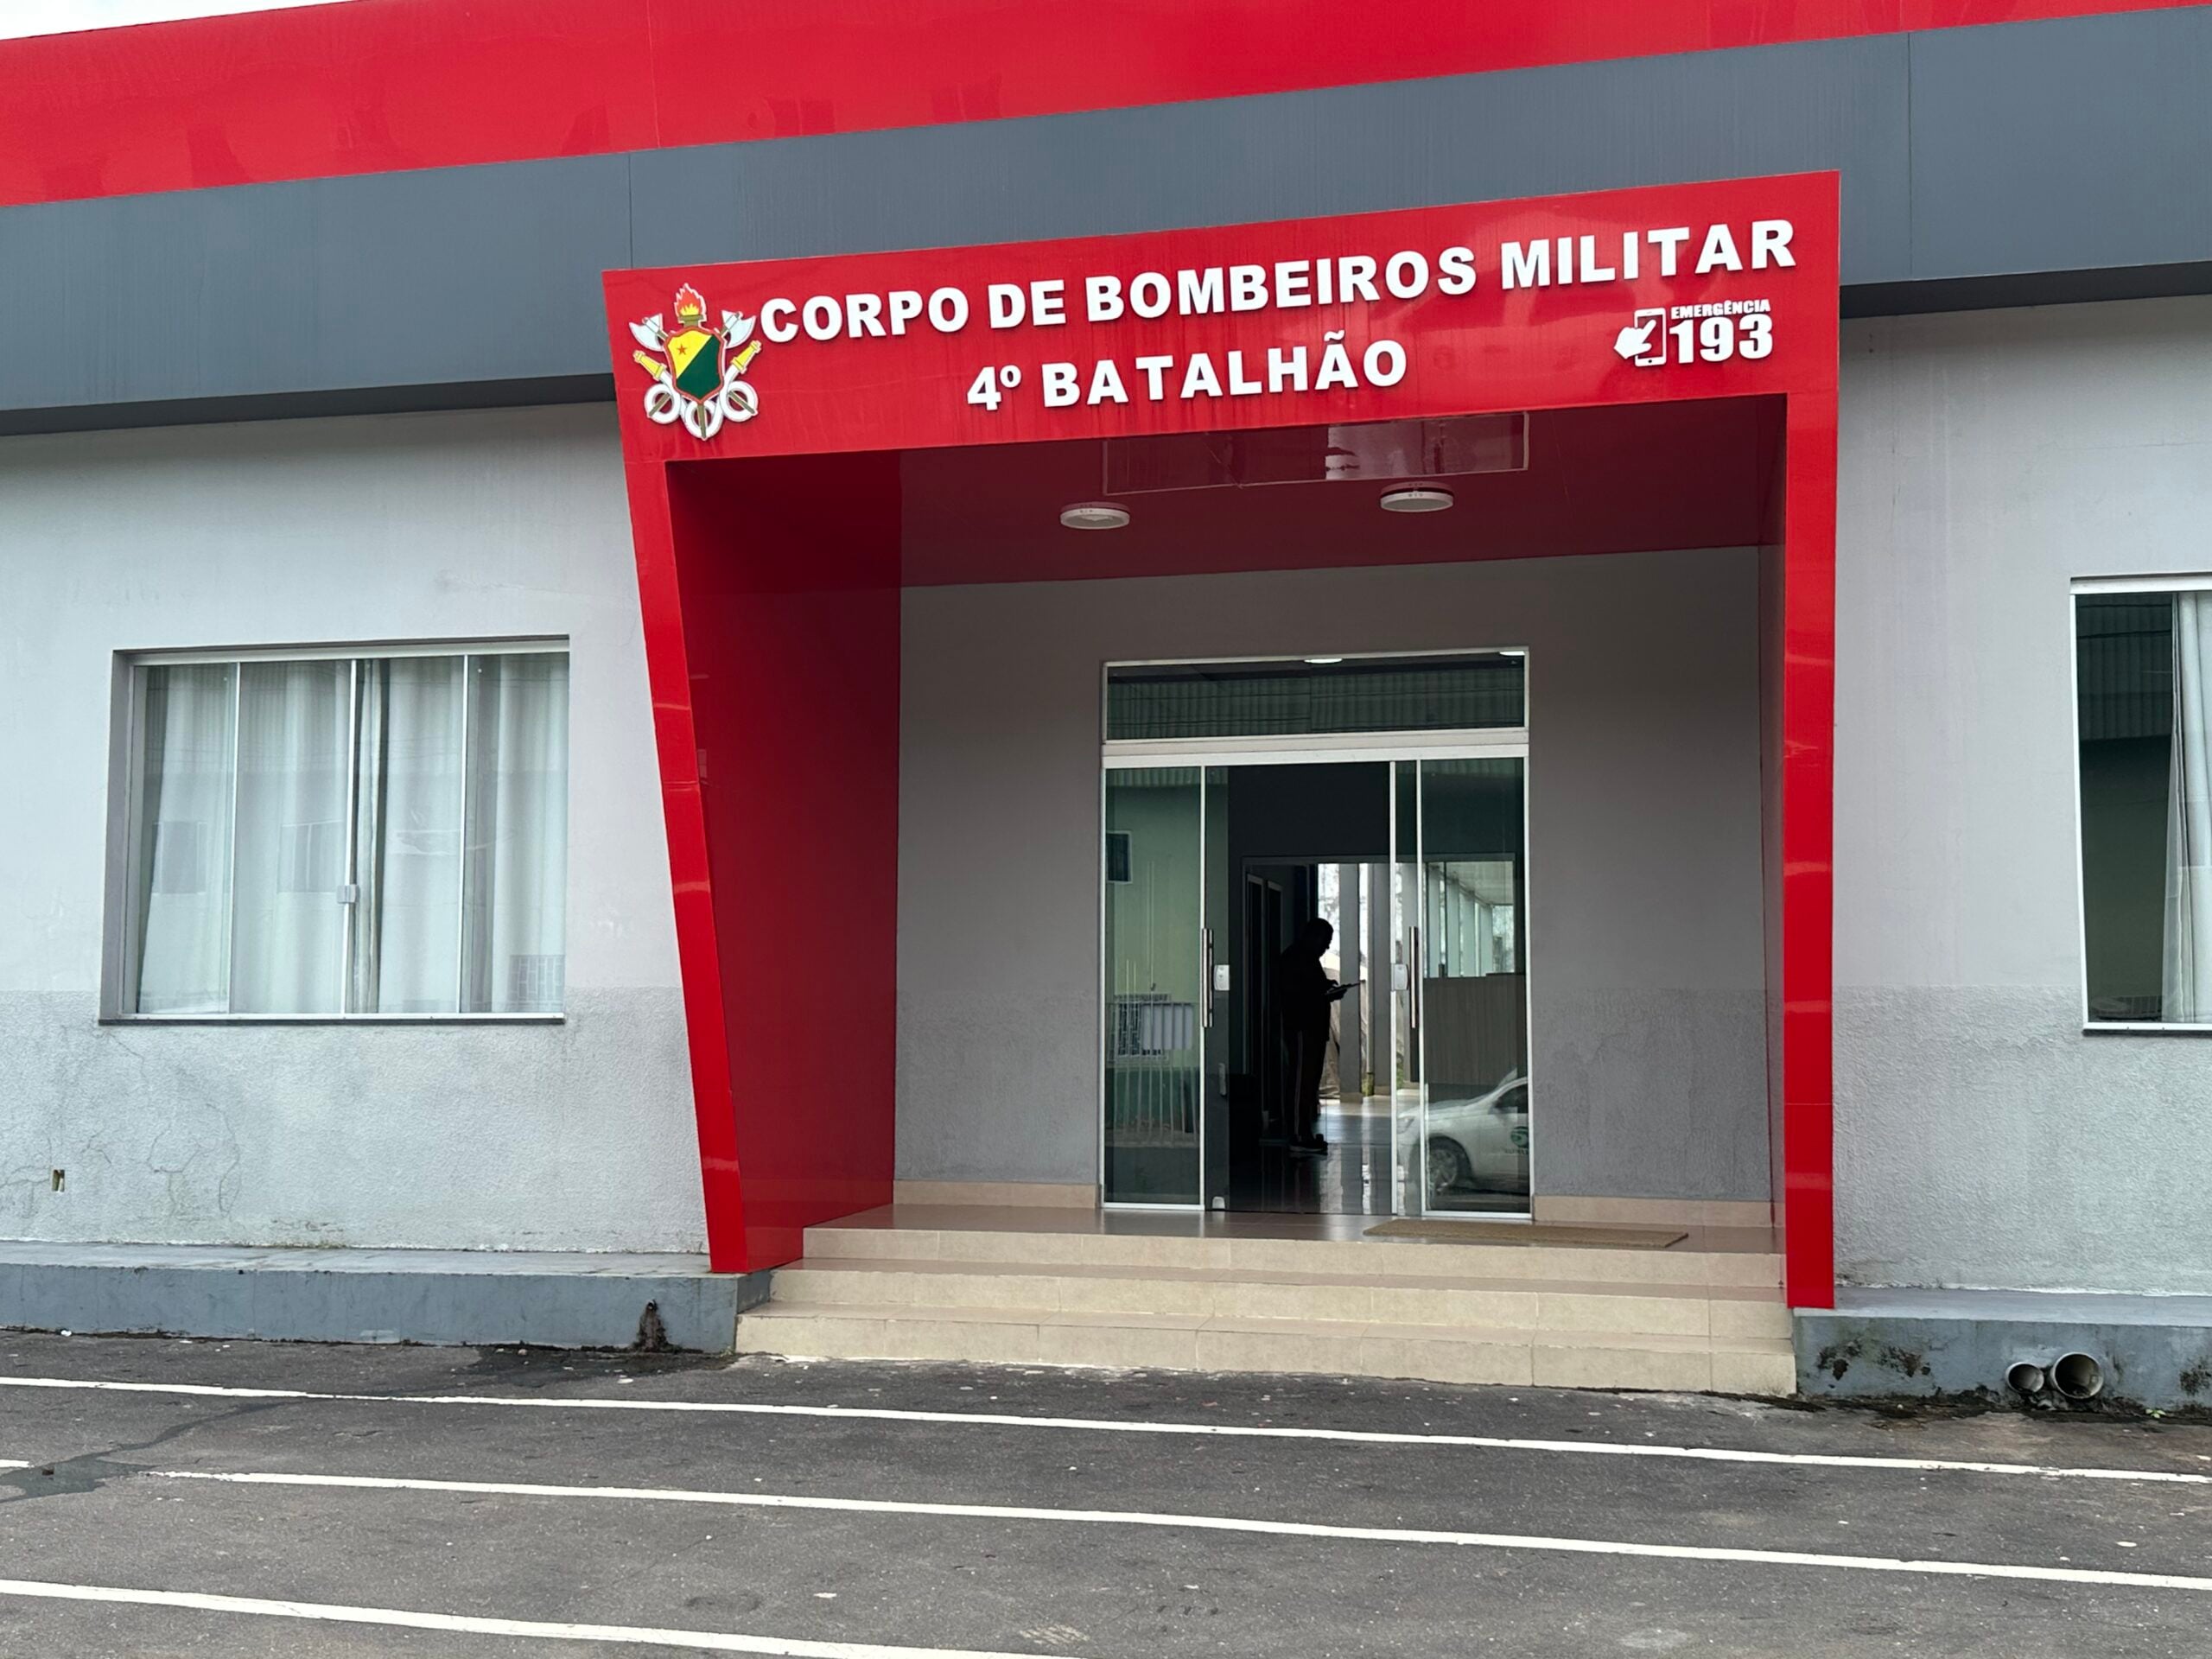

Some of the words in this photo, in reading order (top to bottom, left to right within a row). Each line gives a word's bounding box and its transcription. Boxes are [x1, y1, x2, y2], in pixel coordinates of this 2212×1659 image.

[760, 287, 969, 343] CORPO
[988, 279, 1066, 328] DE
[1085, 246, 1477, 321] BOMBEIROS
[1501, 219, 1796, 289] MILITAR
[1670, 299, 1771, 320] EMERGÊNCIA
[1041, 329, 1407, 407] BATALHÃO
[1669, 313, 1773, 364] 193
